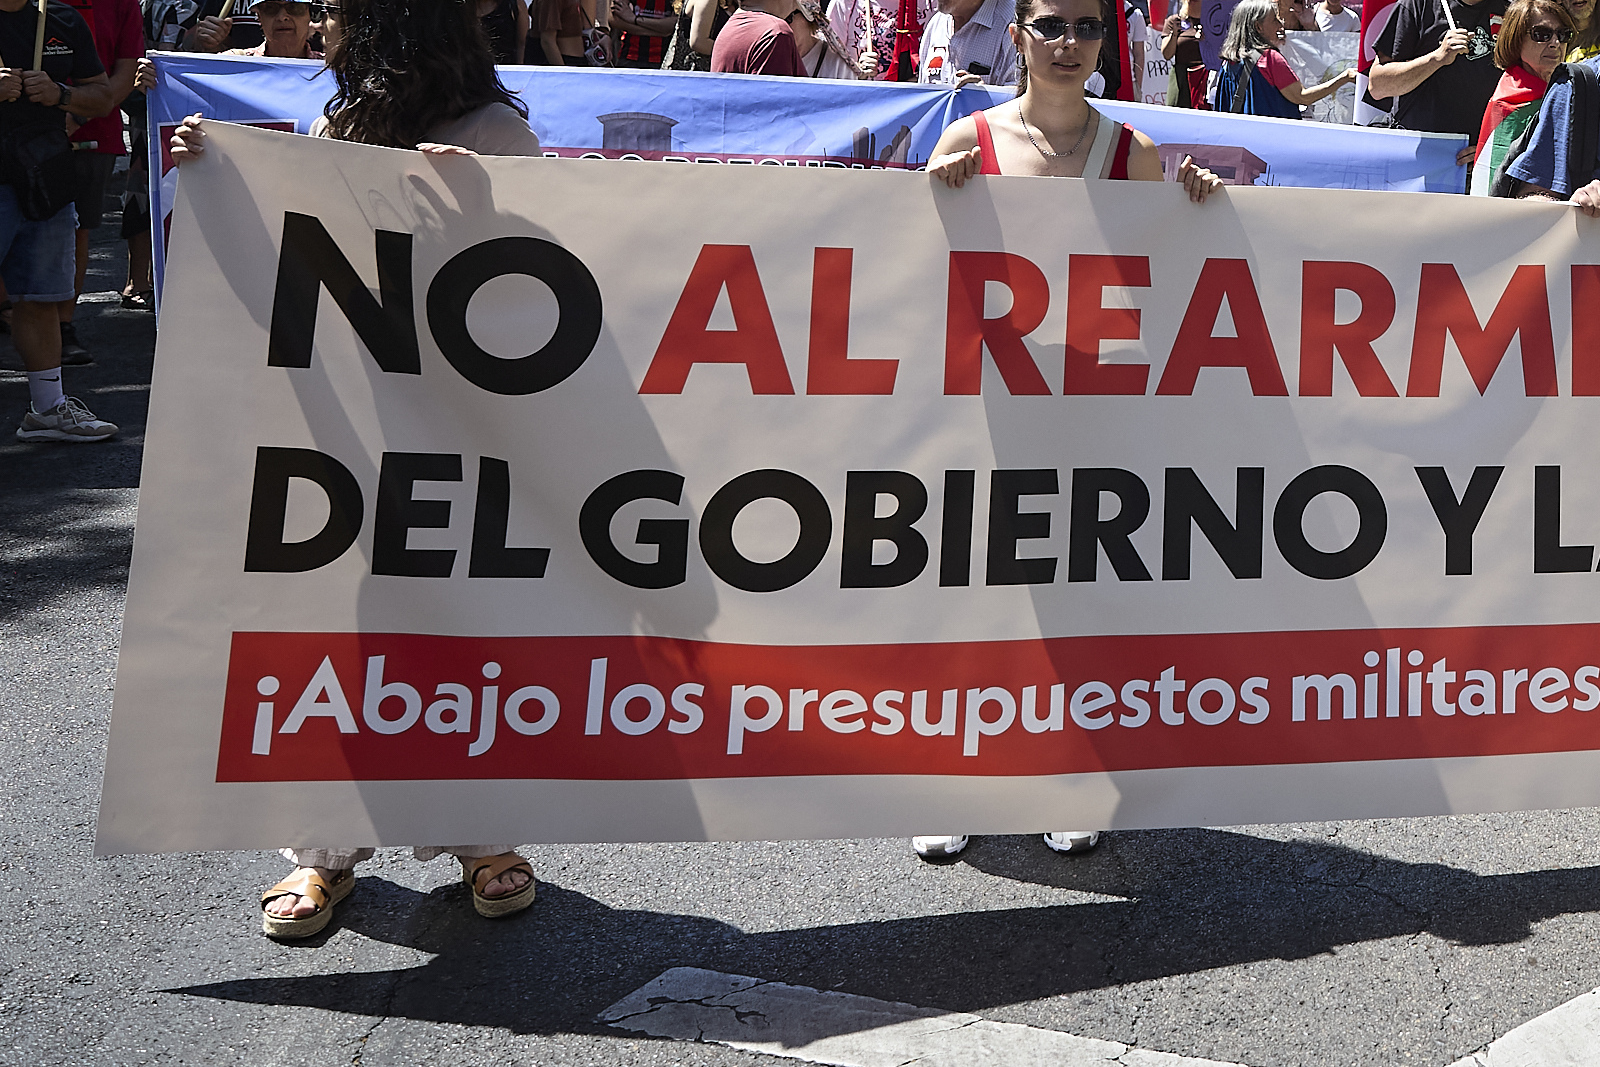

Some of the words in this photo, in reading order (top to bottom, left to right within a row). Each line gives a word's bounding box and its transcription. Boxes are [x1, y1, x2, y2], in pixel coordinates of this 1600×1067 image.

[266, 211, 603, 395] NO
[638, 244, 900, 395] AL
[244, 445, 551, 579] DEL
[579, 464, 1388, 593] GOBIERNO
[1415, 465, 1505, 576] Y
[252, 655, 561, 757] ¡Abajo
[585, 657, 704, 736] los
[727, 665, 1271, 756] presupuestos
